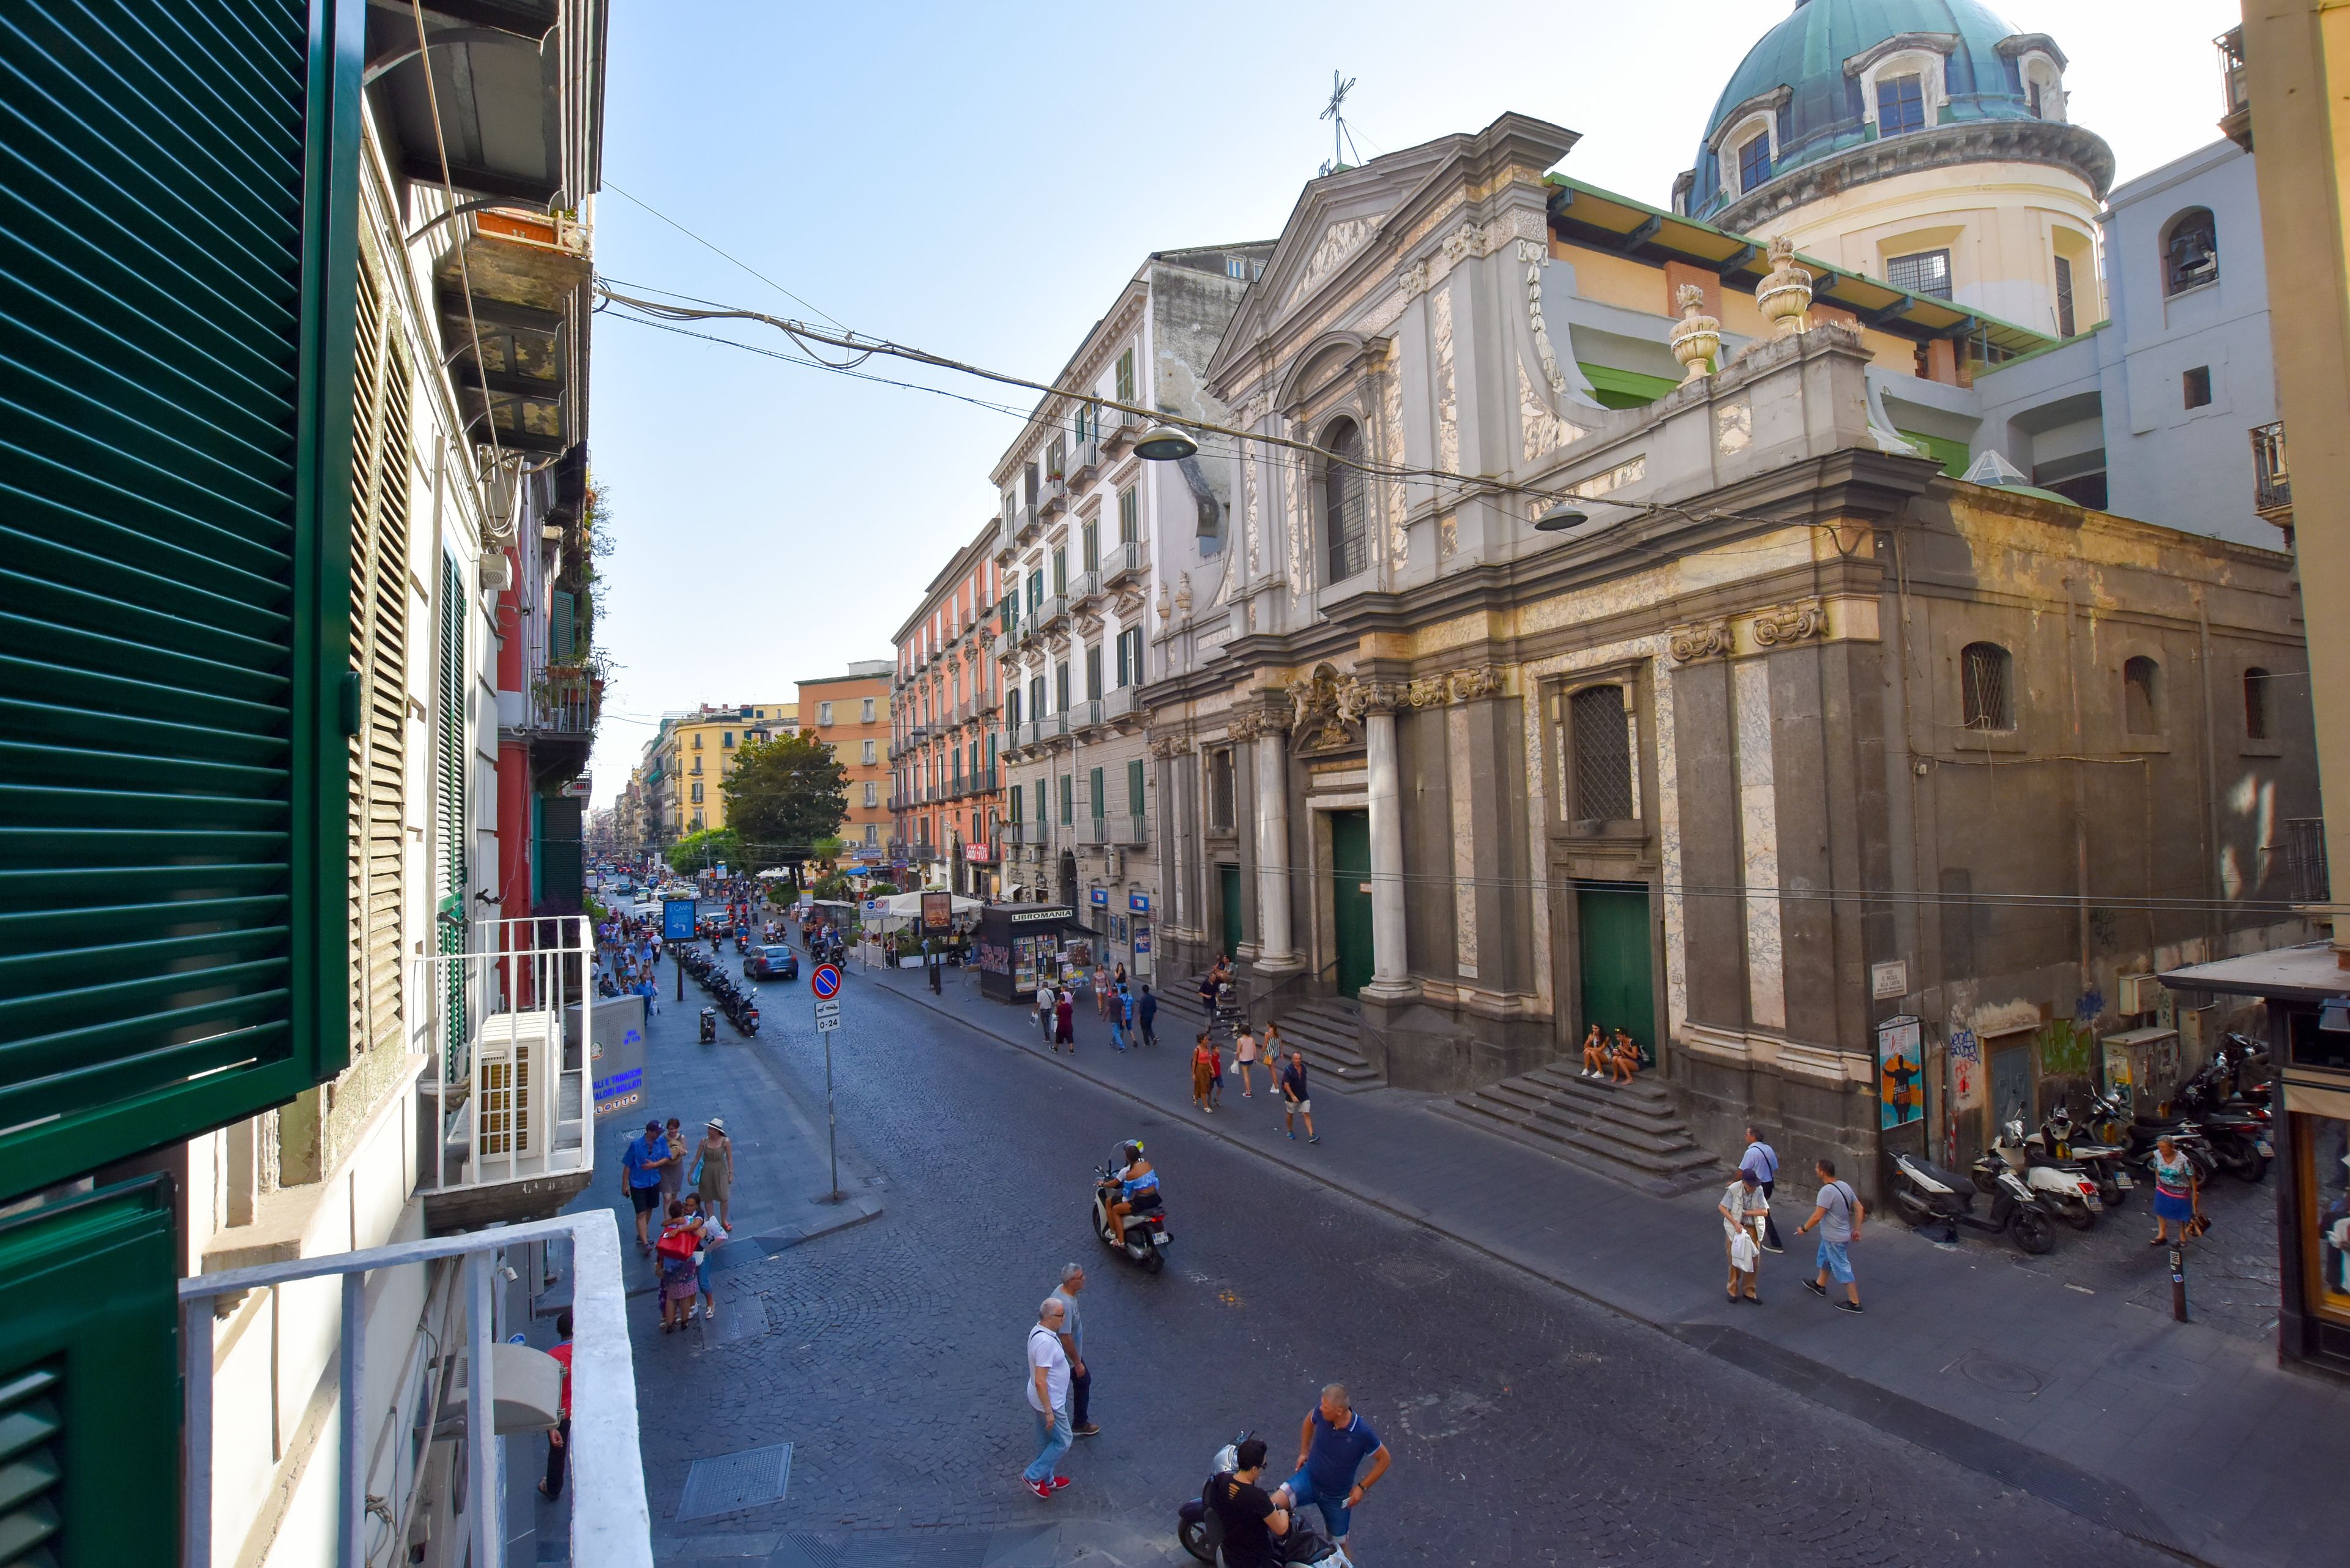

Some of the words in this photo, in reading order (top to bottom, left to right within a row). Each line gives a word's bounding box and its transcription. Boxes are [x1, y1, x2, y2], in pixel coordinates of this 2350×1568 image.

[1013, 910, 1072, 920] LIBROMANIA
[593, 1080, 603, 1090] ALI
[605, 1077, 610, 1086] E
[611, 1067, 643, 1084] TABACCHI
[616, 1078, 642, 1094] BOLLATI
[1894, 1084, 1907, 1095] SPALLE
